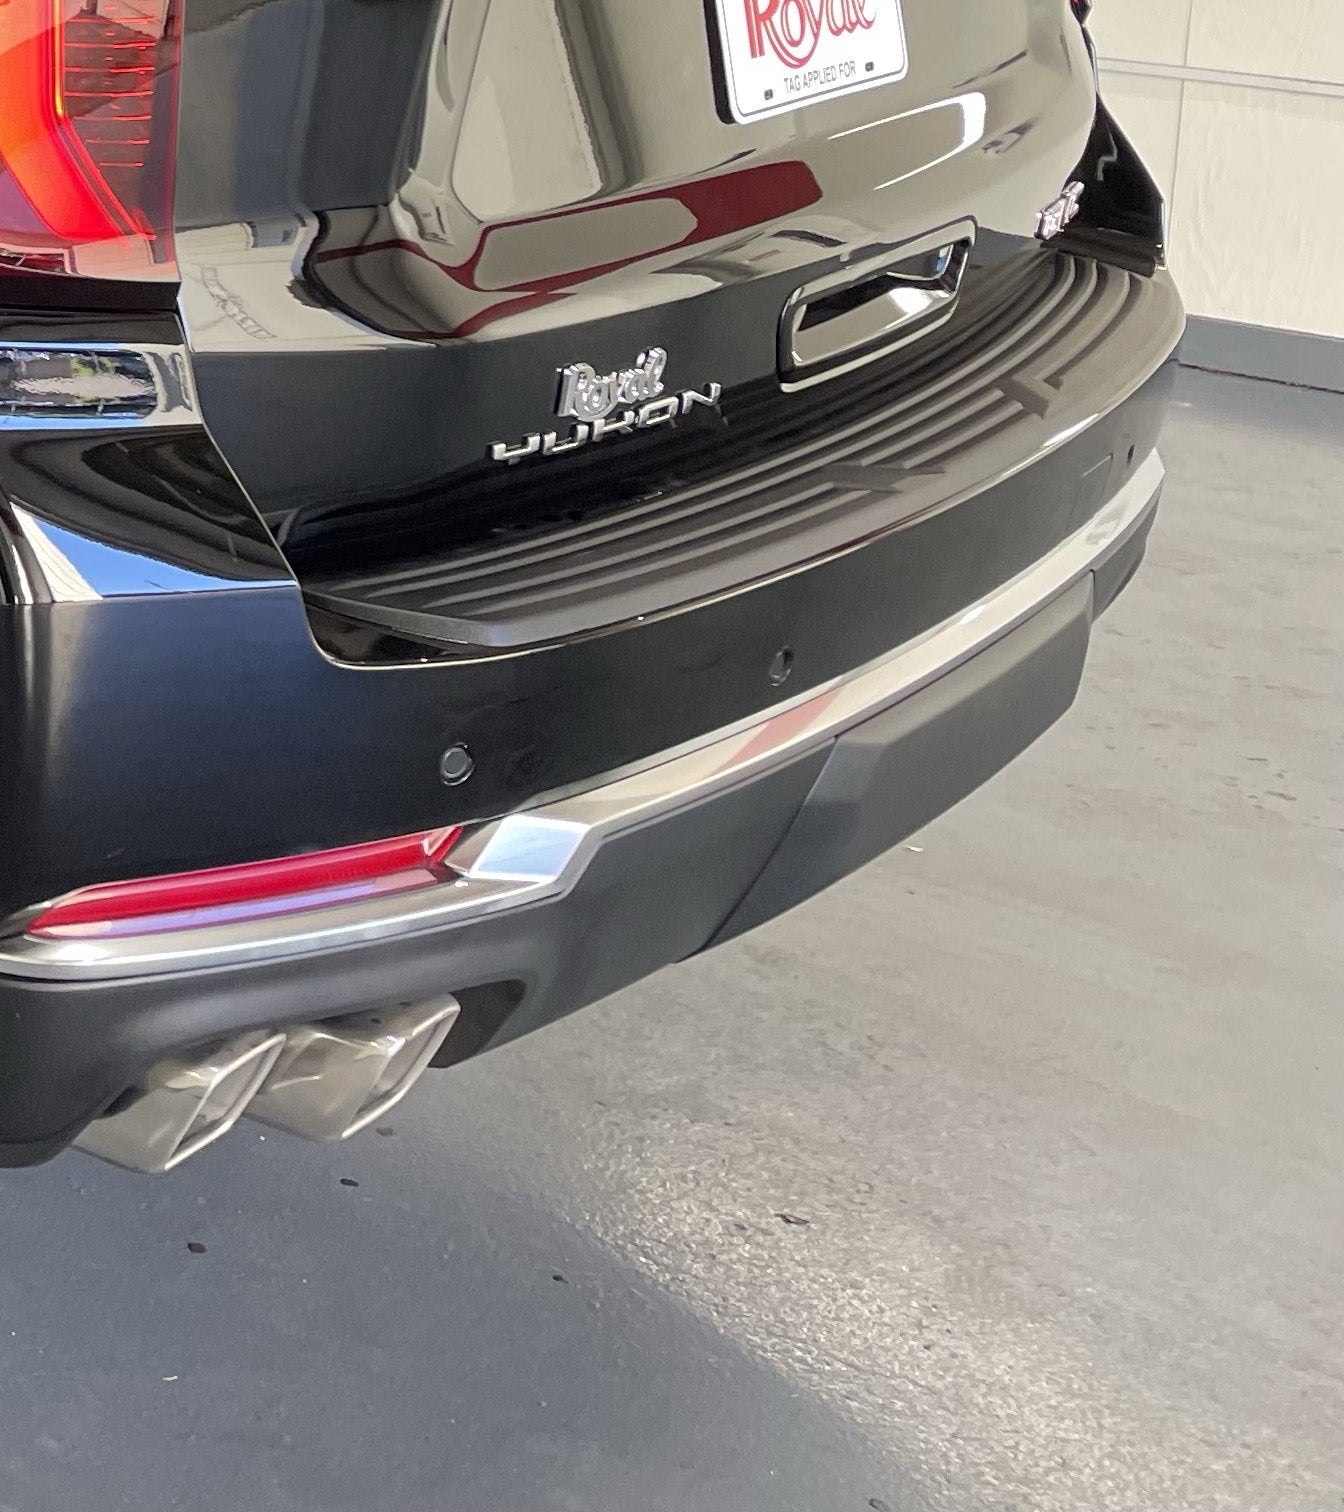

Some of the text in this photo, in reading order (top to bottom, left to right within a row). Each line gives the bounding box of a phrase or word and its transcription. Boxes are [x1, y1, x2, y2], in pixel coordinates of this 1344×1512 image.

[784, 61, 856, 93] TAG APPLIED FOR
[486, 382, 723, 464] YUKON
[554, 346, 668, 423] Royal
